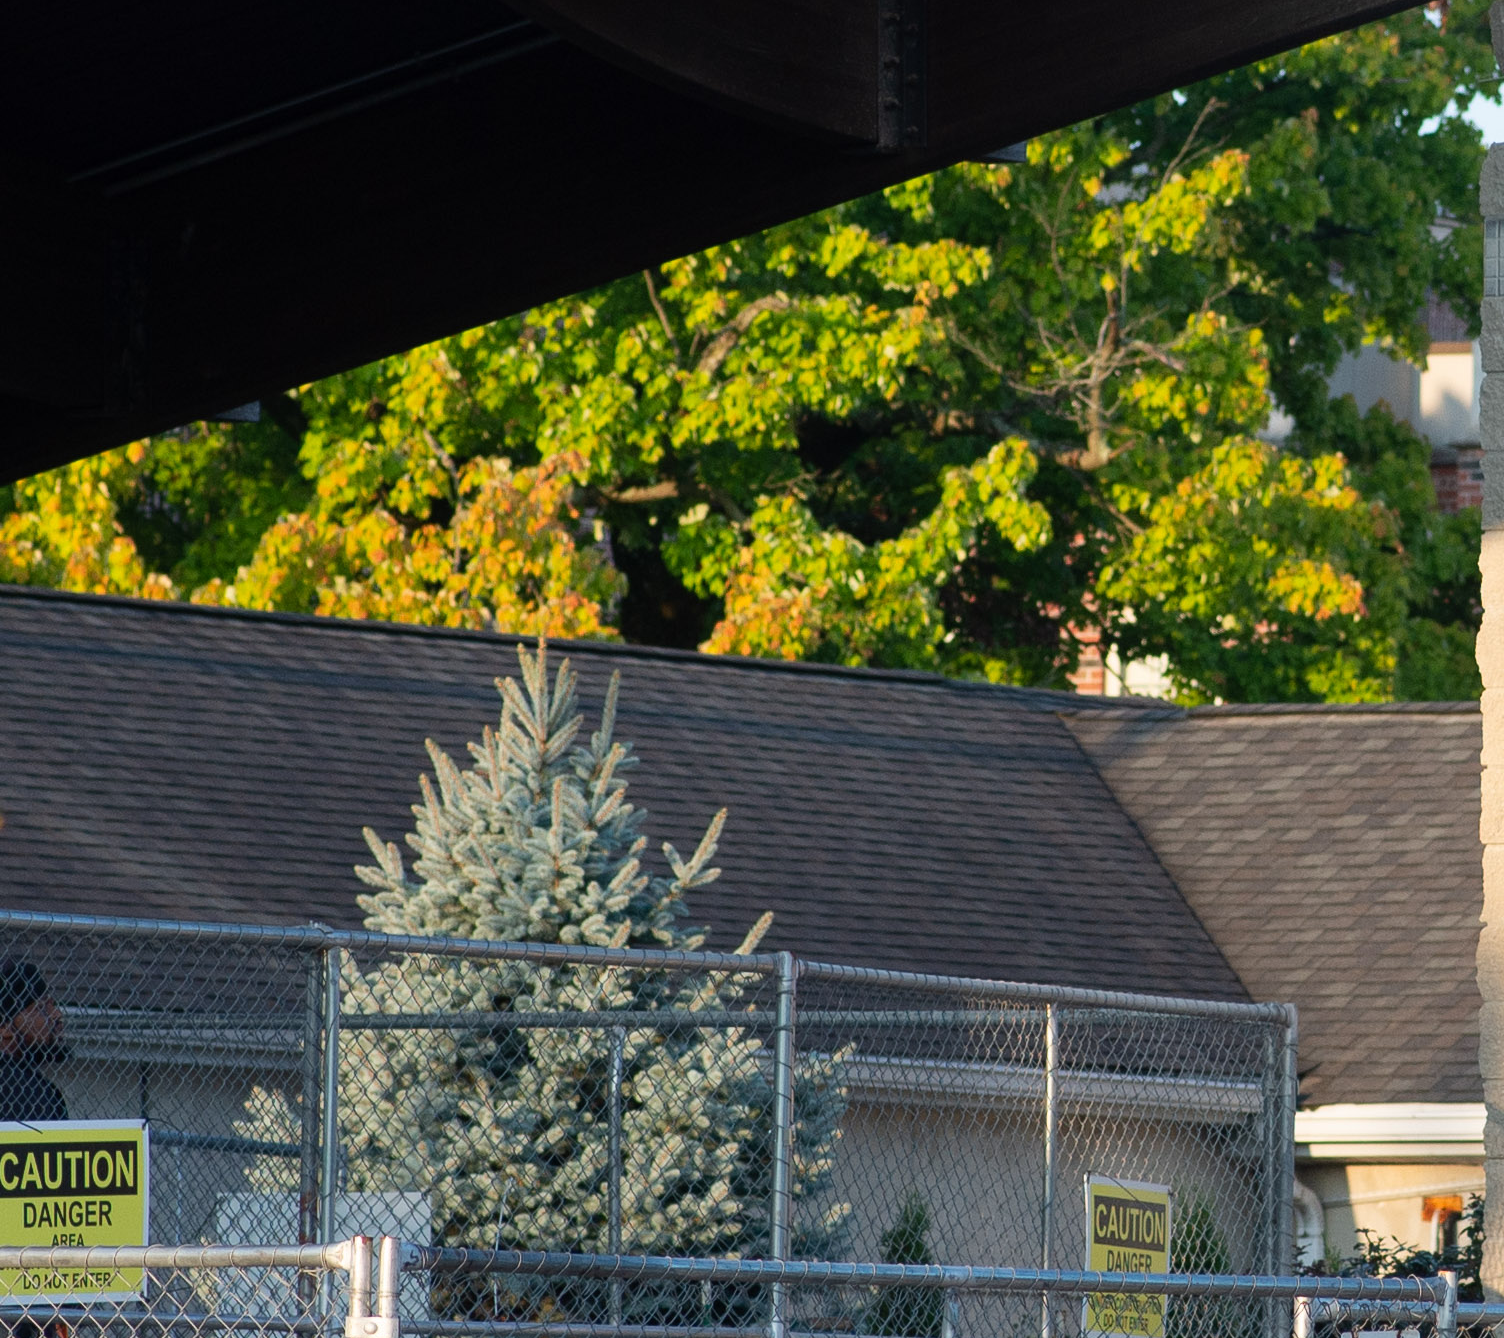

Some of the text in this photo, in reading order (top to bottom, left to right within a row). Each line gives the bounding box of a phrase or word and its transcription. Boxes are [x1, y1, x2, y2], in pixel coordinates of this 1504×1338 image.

[0, 1150, 134, 1191] CAUTION
[23, 1200, 112, 1228] DANGER
[1096, 1203, 1164, 1245] CAUTION
[1107, 1249, 1152, 1273] DANGER
[23, 1272, 112, 1290] DO NOT ENTER
